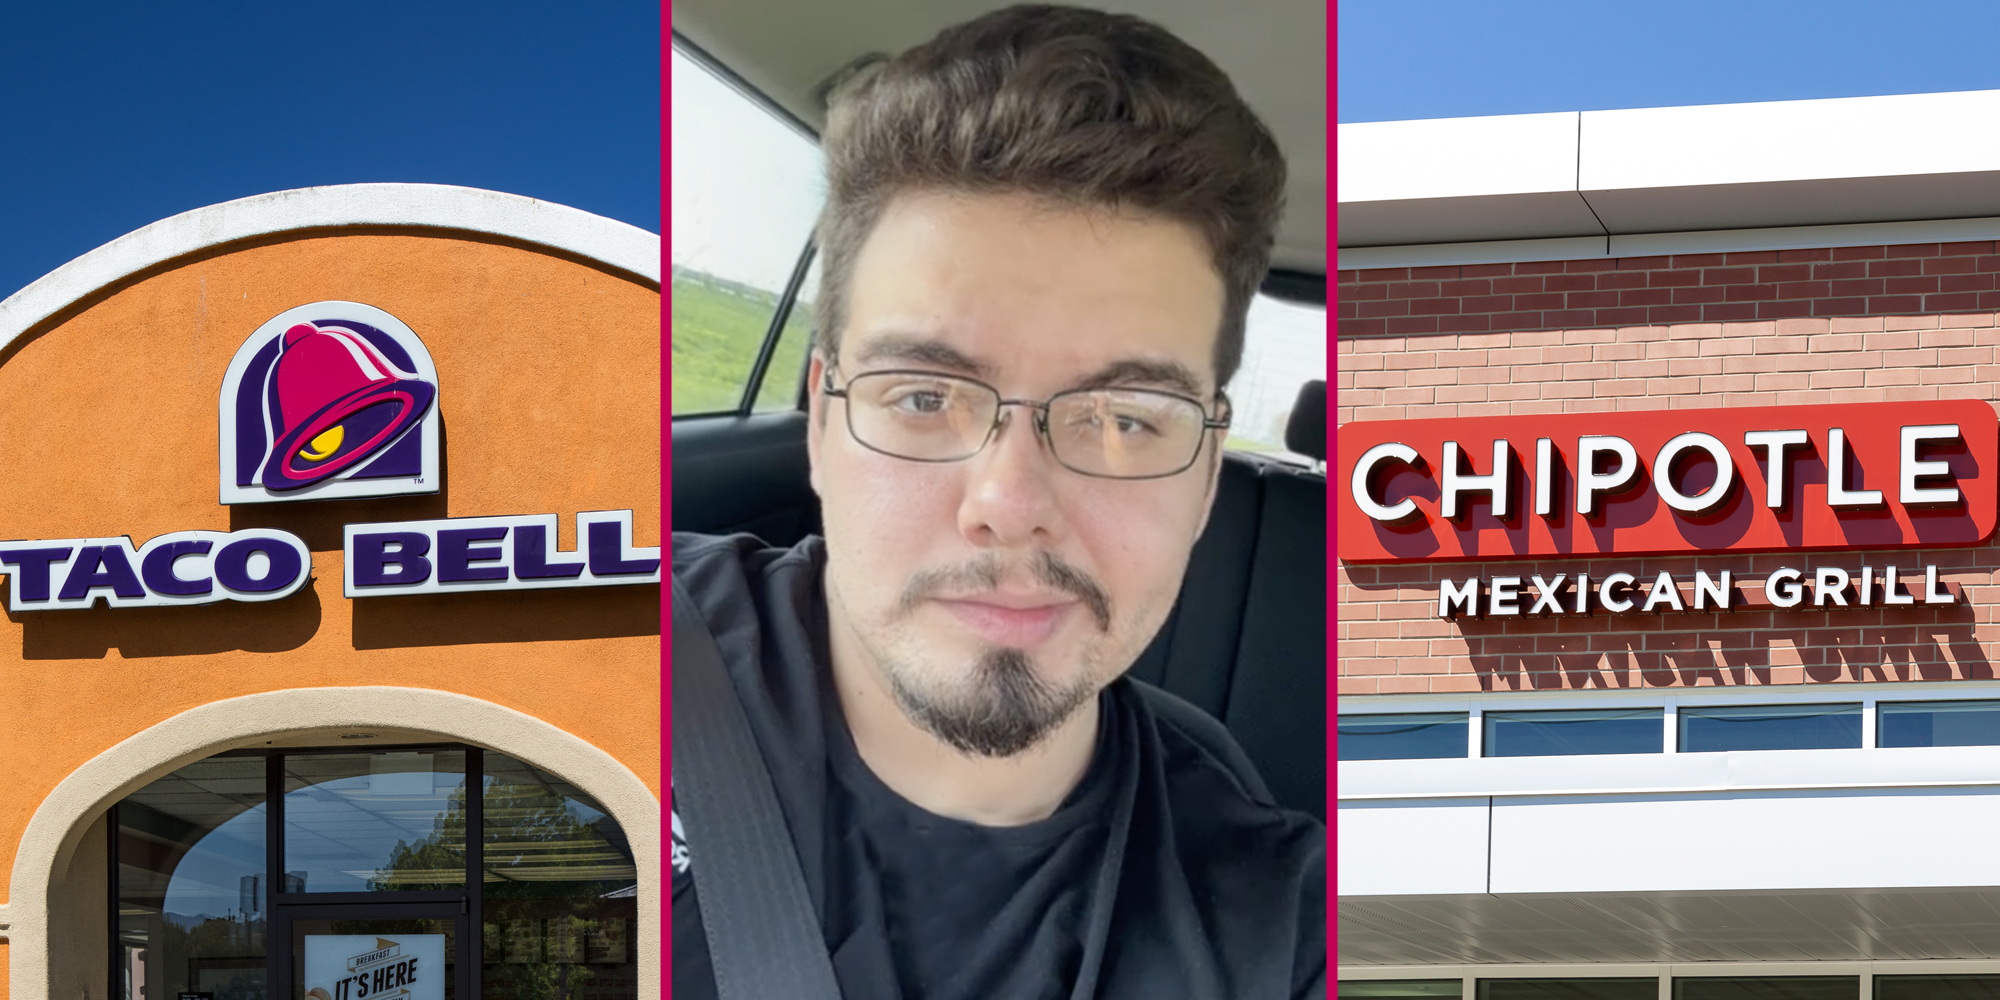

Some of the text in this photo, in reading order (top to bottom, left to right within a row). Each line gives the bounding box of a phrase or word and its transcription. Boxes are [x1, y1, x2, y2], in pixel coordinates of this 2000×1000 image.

[413, 477, 425, 485] TM
[1351, 424, 1961, 521] CHIPOTLE
[0, 521, 661, 601] TACO BELL
[1438, 565, 1956, 616] MEXICAN GRILL
[335, 957, 418, 1000] IT'S HERE
[355, 949, 391, 966] BREAKFAST
